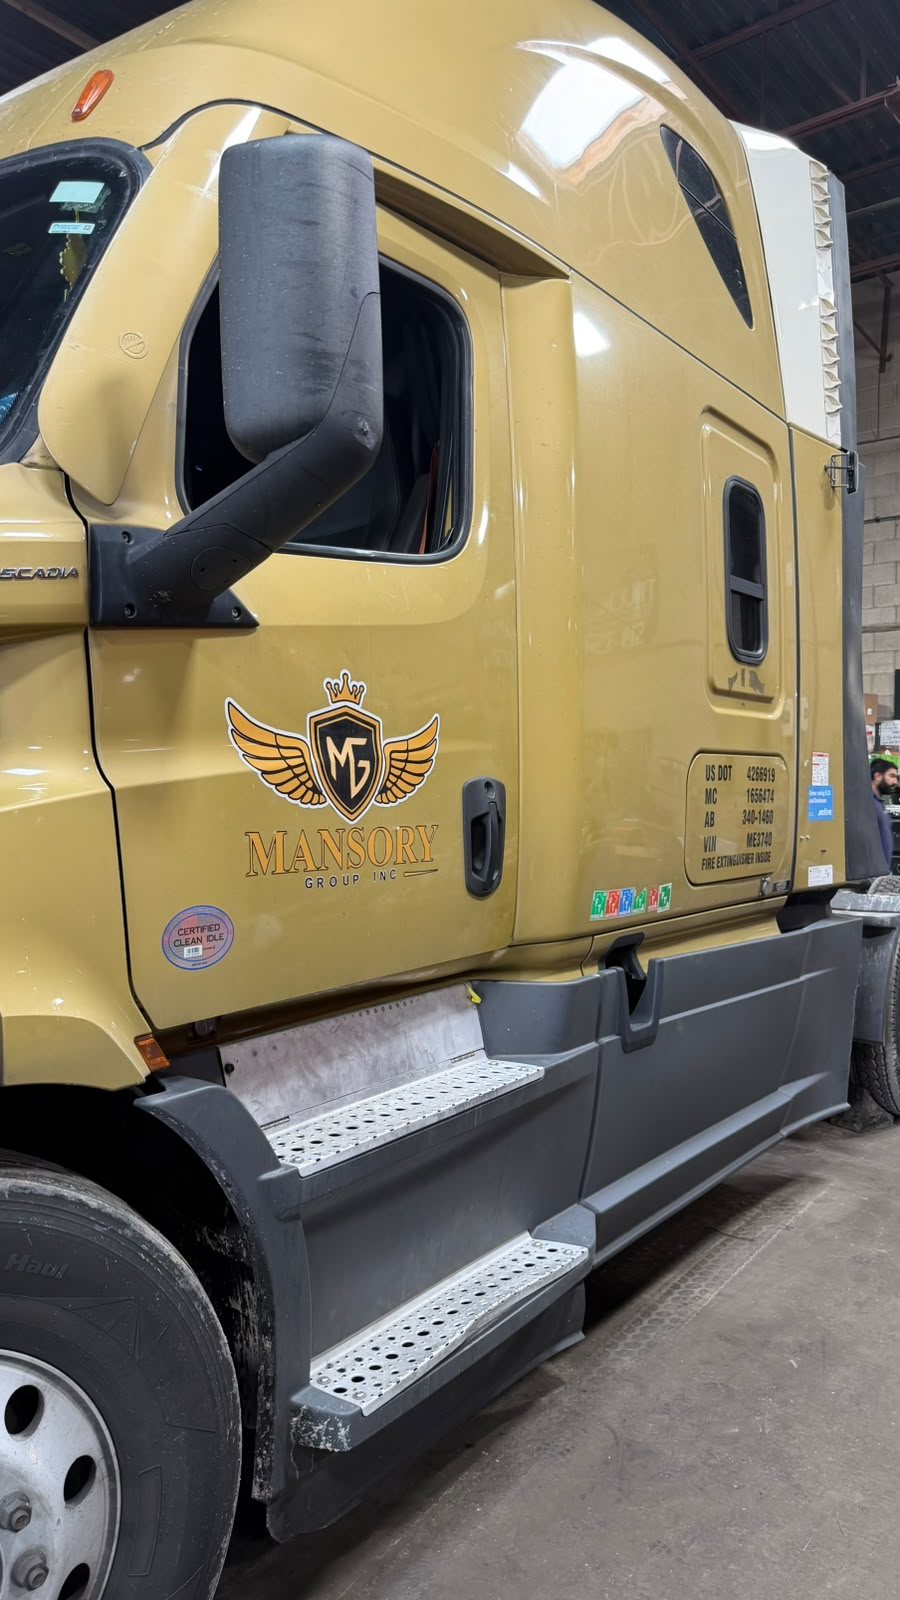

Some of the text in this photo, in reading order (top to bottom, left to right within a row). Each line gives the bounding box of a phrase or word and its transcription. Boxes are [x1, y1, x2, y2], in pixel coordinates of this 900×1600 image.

[326, 736, 371, 799] MG
[705, 765, 775, 783] US DOT 4266919
[704, 788, 774, 804] MC 1656474
[704, 809, 773, 828] AB 340-1460
[245, 825, 439, 878] MANSORY
[703, 832, 772, 853] VIN ME3740
[701, 851, 771, 871] FIRE EXTINGUISHER INSIDE
[305, 869, 397, 889] GROUP INC
[177, 923, 220, 936] CERTIFIED
[173, 933, 224, 947] CLEAN IDLE
[4, 1253, 70, 1280] Haul
